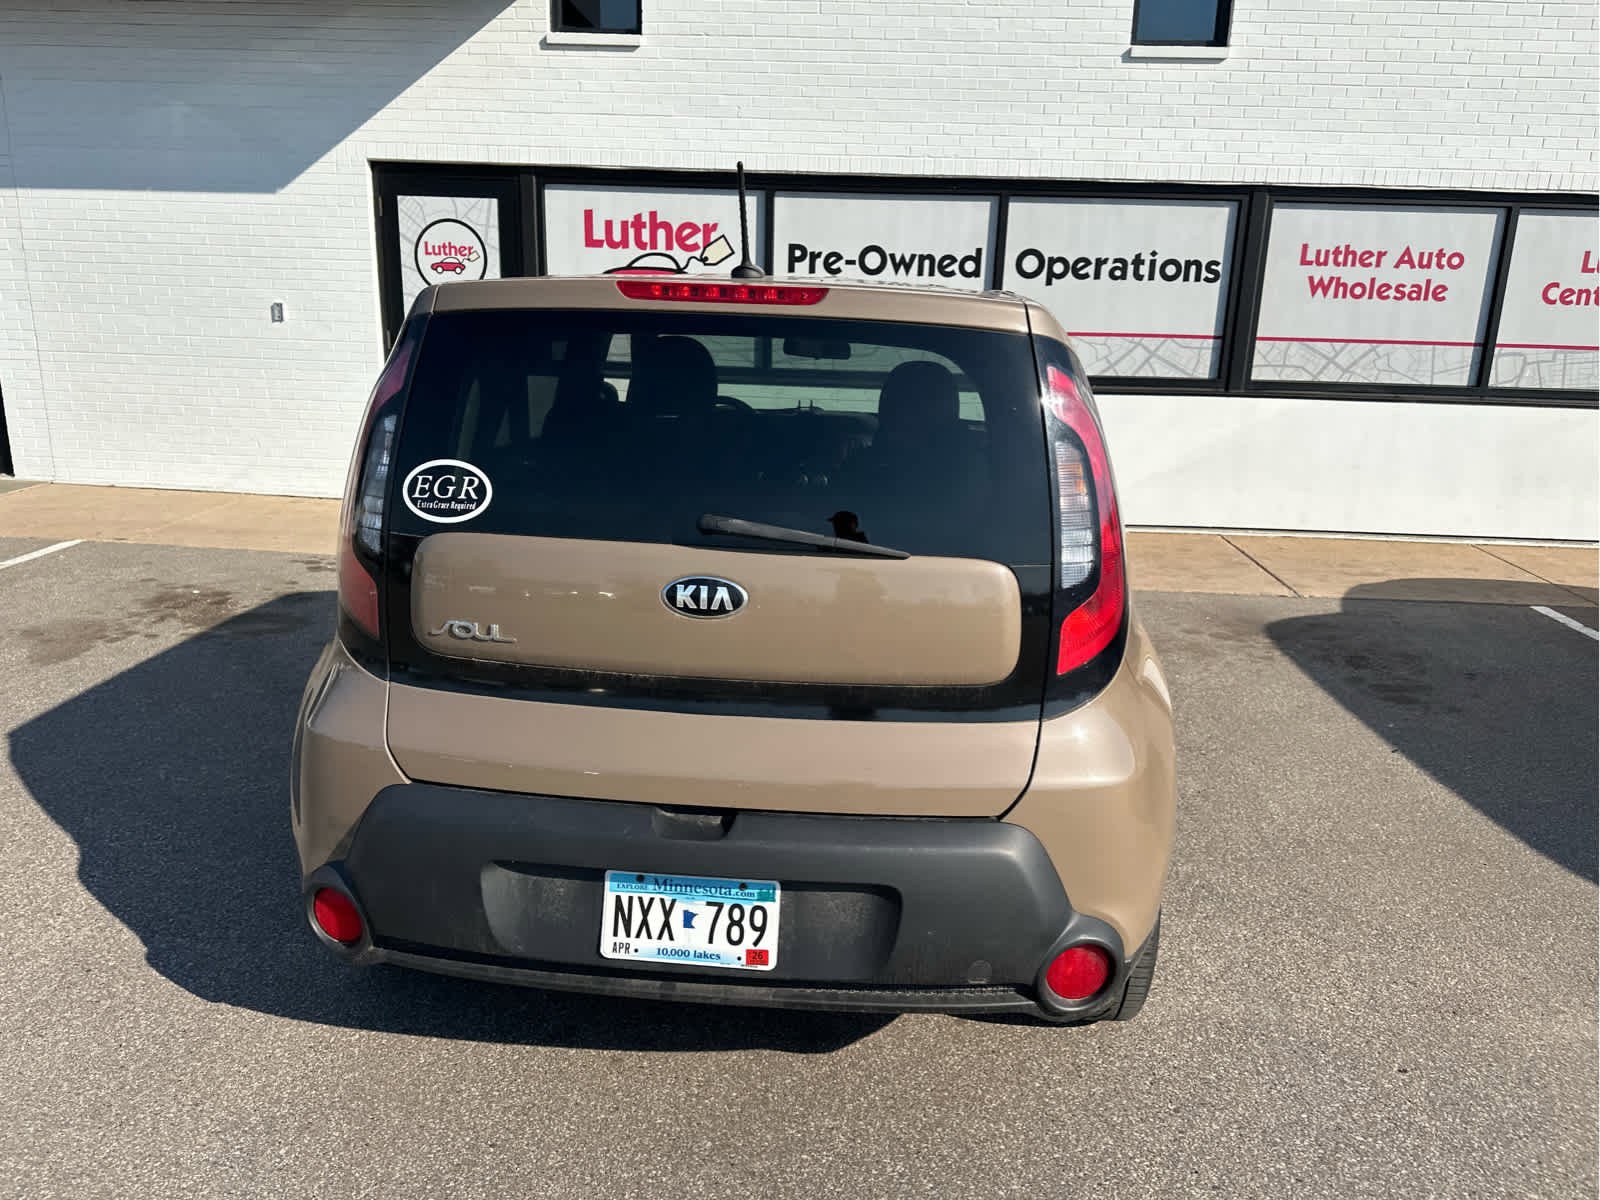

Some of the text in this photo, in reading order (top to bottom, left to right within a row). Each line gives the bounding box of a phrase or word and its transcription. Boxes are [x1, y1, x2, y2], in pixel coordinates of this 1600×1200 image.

[583, 209, 719, 252] Luther
[424, 241, 474, 257] Luther
[1300, 243, 1465, 270] Luther Auto
[787, 243, 1222, 286] Pre-Owned Operations
[1581, 250, 1599, 273] L
[1307, 275, 1449, 302] Wholesale
[411, 474, 480, 500] EGR
[416, 500, 477, 512] Extra Grace Required
[676, 584, 734, 611] KIA
[616, 877, 756, 898] EXPLORE Minnesota.com
[612, 894, 768, 948] NXX 789
[612, 941, 631, 955] APR
[656, 947, 721, 961] 10,000 lakes
[751, 951, 763, 961] 26
